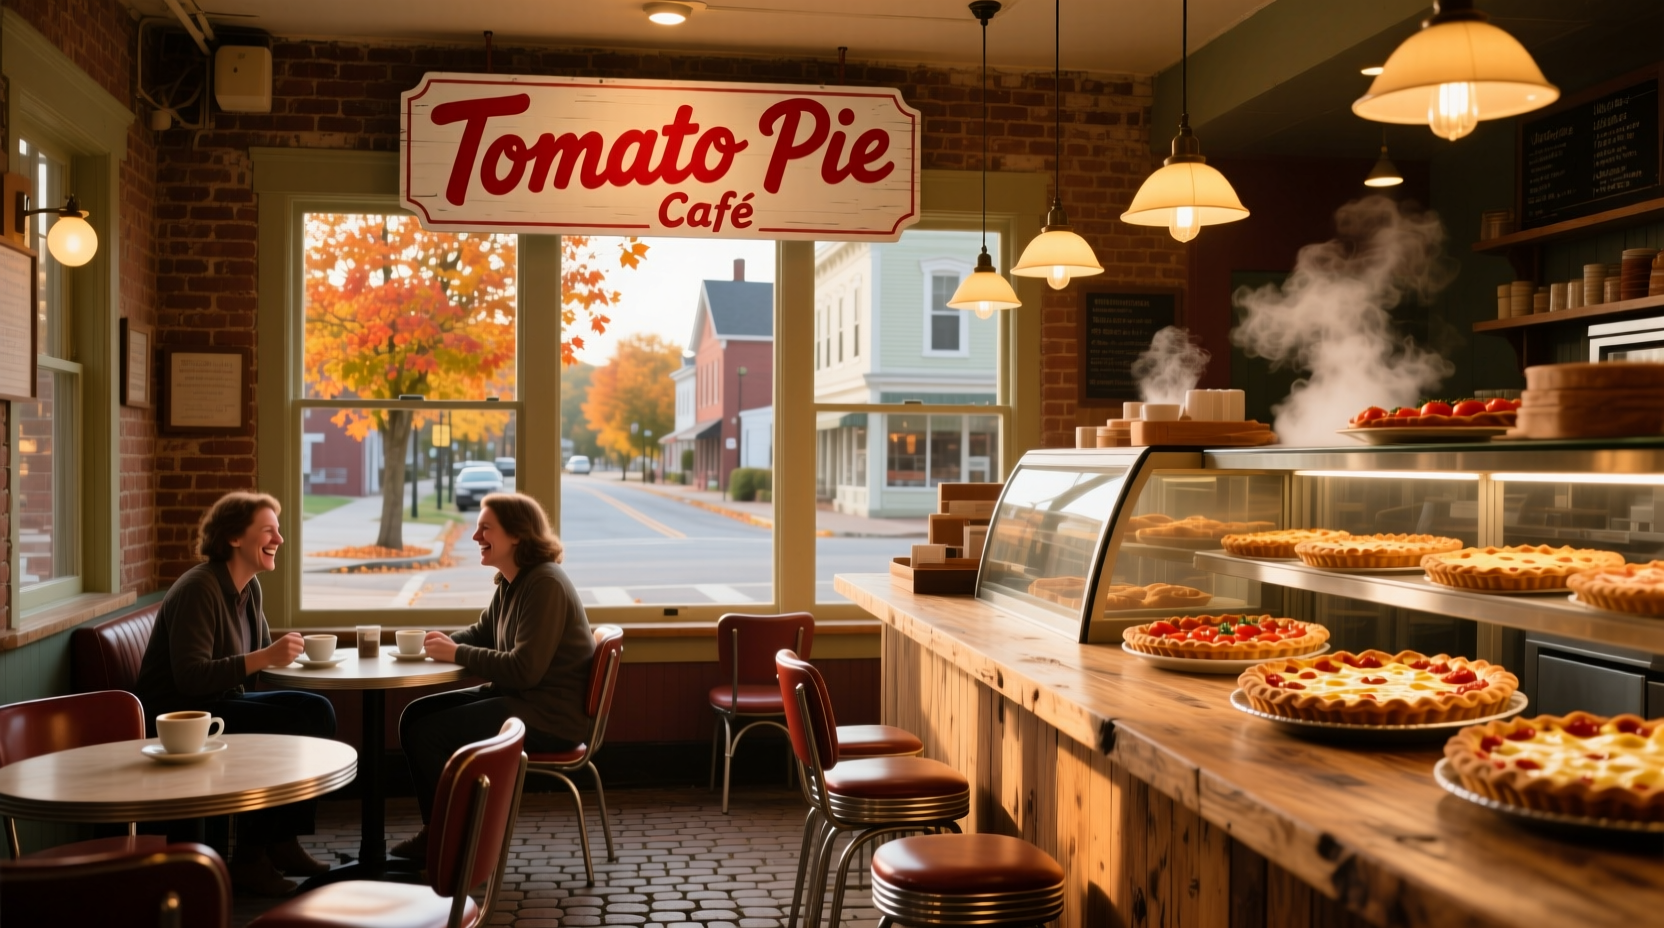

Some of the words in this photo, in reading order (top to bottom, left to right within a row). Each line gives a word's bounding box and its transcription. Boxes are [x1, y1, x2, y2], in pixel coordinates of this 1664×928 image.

[431, 93, 748, 204] Tomato
[759, 97, 895, 193] Pie
[659, 191, 754, 233] Café
